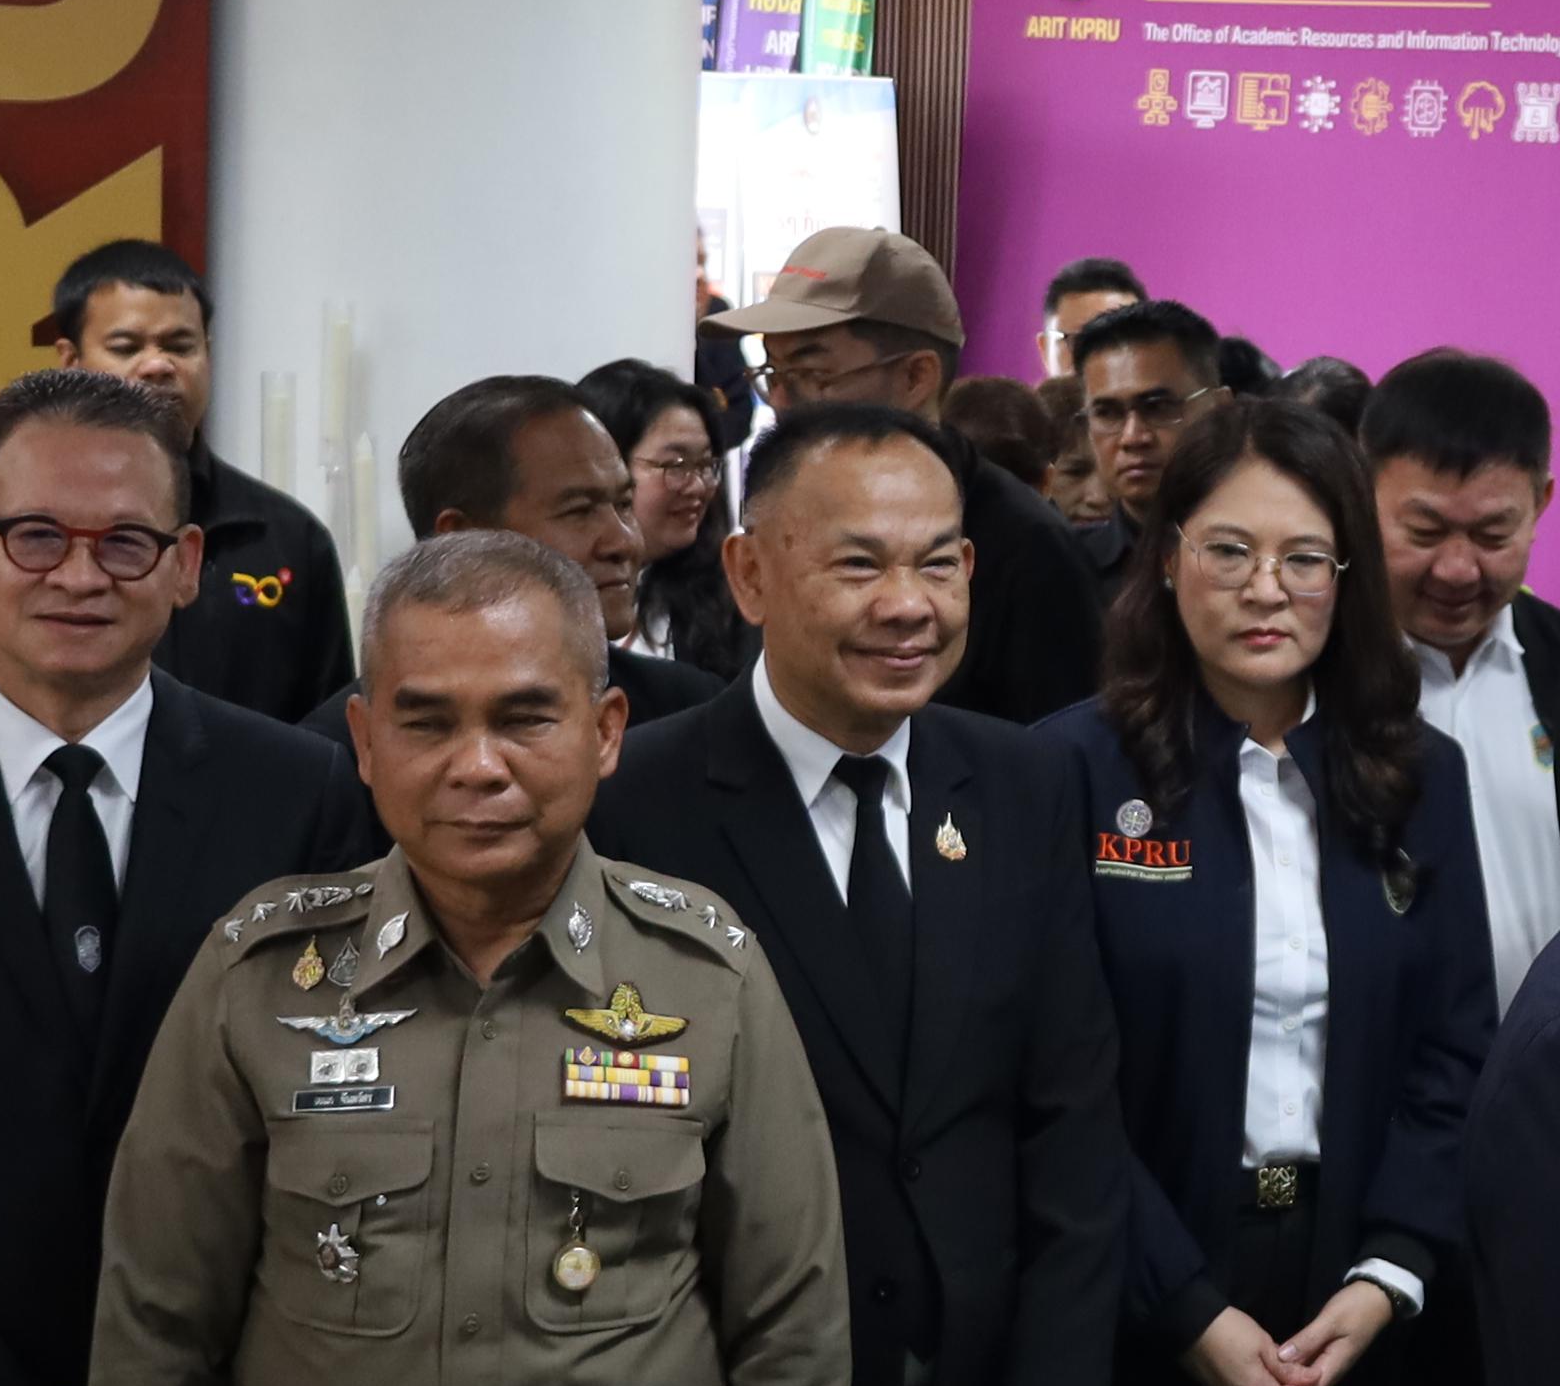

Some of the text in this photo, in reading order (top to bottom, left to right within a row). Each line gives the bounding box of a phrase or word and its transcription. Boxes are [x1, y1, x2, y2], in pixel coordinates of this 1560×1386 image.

[1025, 16, 1121, 41] ARIT KPRU
[1145, 22, 1170, 42] The
[1171, 23, 1214, 43] Office
[1215, 24, 1230, 44] of
[1231, 24, 1299, 46] Academic
[1301, 27, 1374, 49] Resources
[1377, 29, 1405, 50] and
[1406, 29, 1489, 51] Information
[1097, 832, 1192, 865] KPRU
